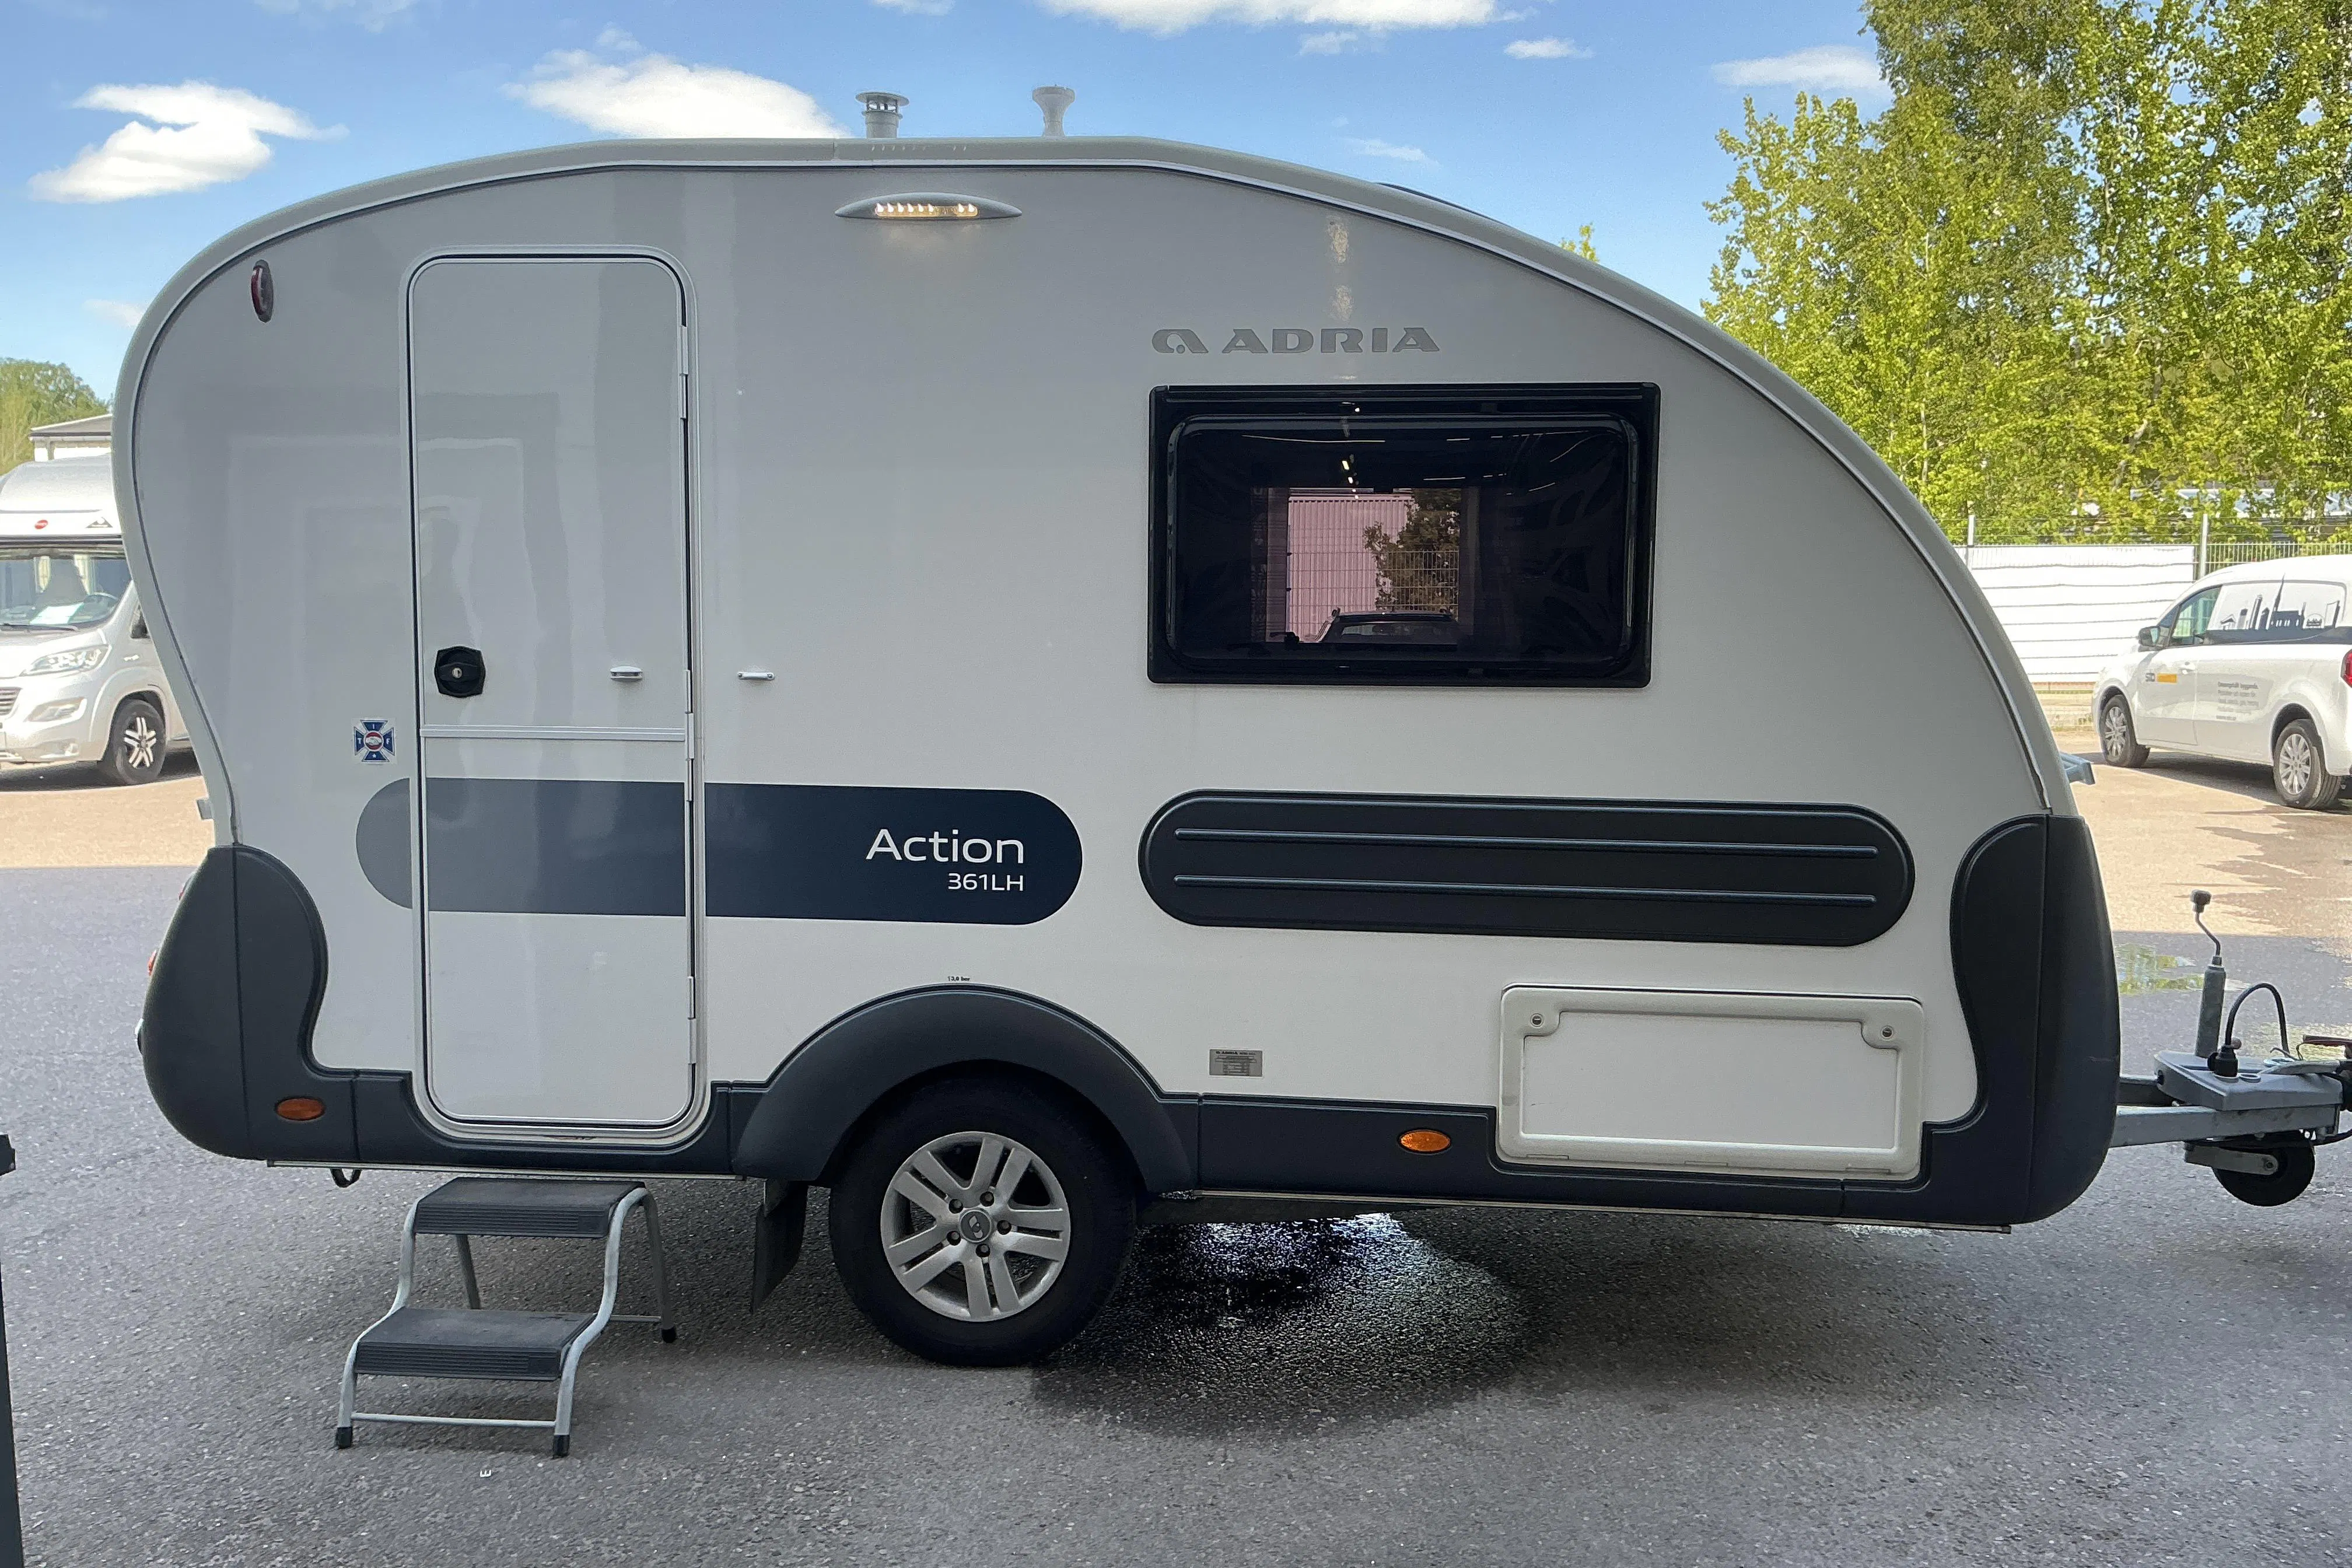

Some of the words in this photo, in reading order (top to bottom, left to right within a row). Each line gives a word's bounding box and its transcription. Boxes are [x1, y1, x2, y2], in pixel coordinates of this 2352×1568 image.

[1222, 327, 1440, 354] ADRIA
[866, 828, 1024, 864] Action
[948, 873, 1024, 891] 361LH
